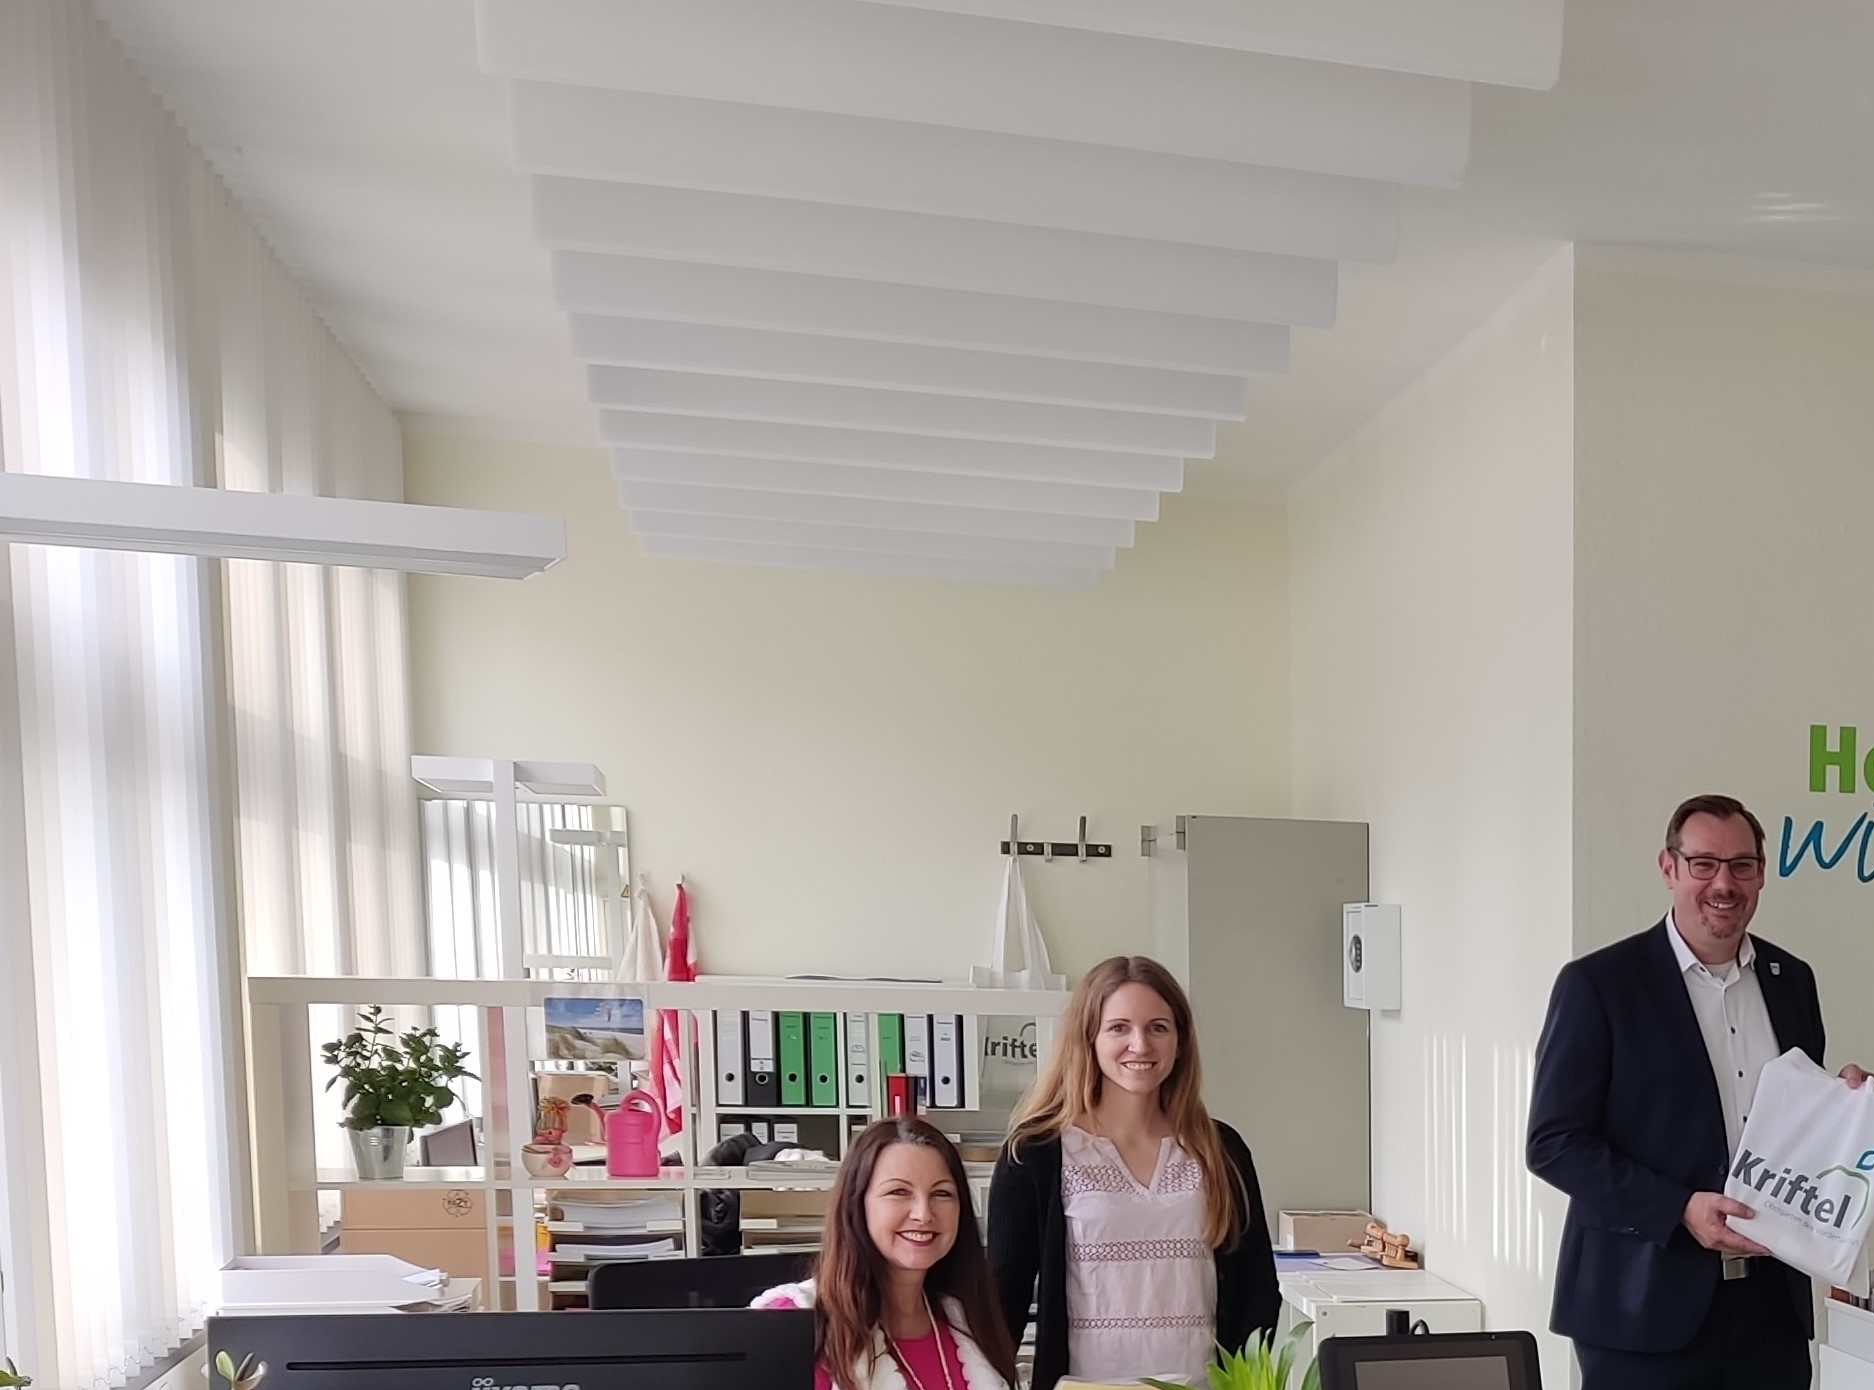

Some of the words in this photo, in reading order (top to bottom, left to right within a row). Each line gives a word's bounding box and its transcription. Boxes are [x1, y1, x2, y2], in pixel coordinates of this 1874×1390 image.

[984, 1036, 1038, 1059] rifte
[1731, 1148, 1852, 1229] Kriftel
[1816, 1226, 1860, 1247] Vordertnus
